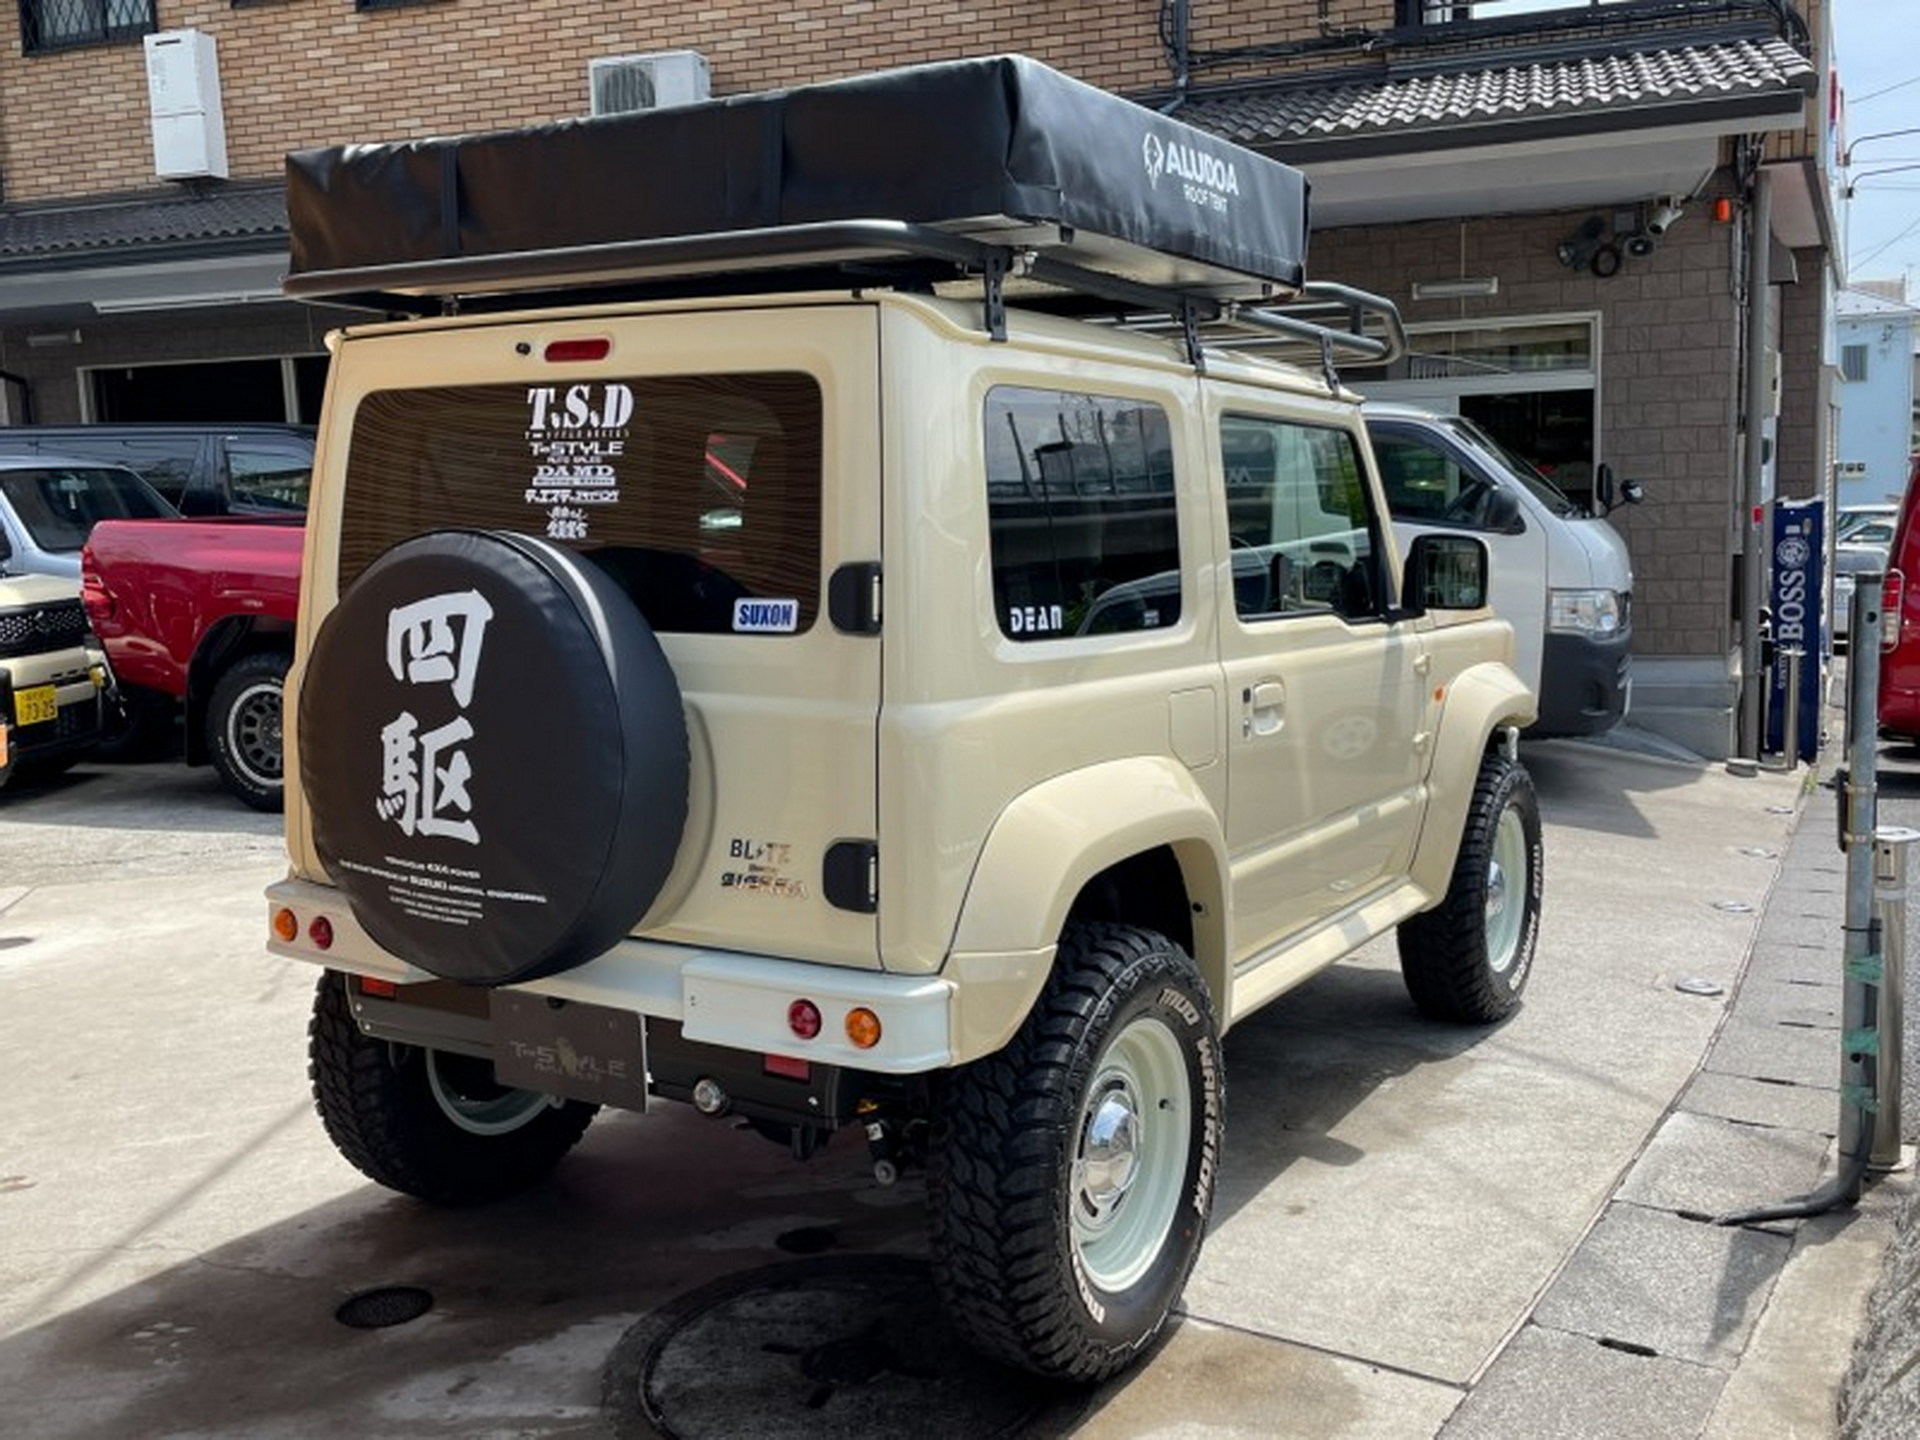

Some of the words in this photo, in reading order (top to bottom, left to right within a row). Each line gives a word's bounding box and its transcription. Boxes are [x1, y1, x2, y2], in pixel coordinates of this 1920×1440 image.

[527, 384, 634, 430] T.S.D
[529, 441, 625, 456] T-STYLE
[537, 465, 615, 476] DAMD
[738, 604, 793, 626] SUXON
[1010, 605, 1062, 632] DEAN
[1778, 569, 1806, 641] BOSS
[376, 589, 494, 844] 四駆
[409, 875, 448, 891] SUZUKI
[1158, 987, 1200, 1026] MUD
[1195, 1036, 1218, 1216] WARRIOR
